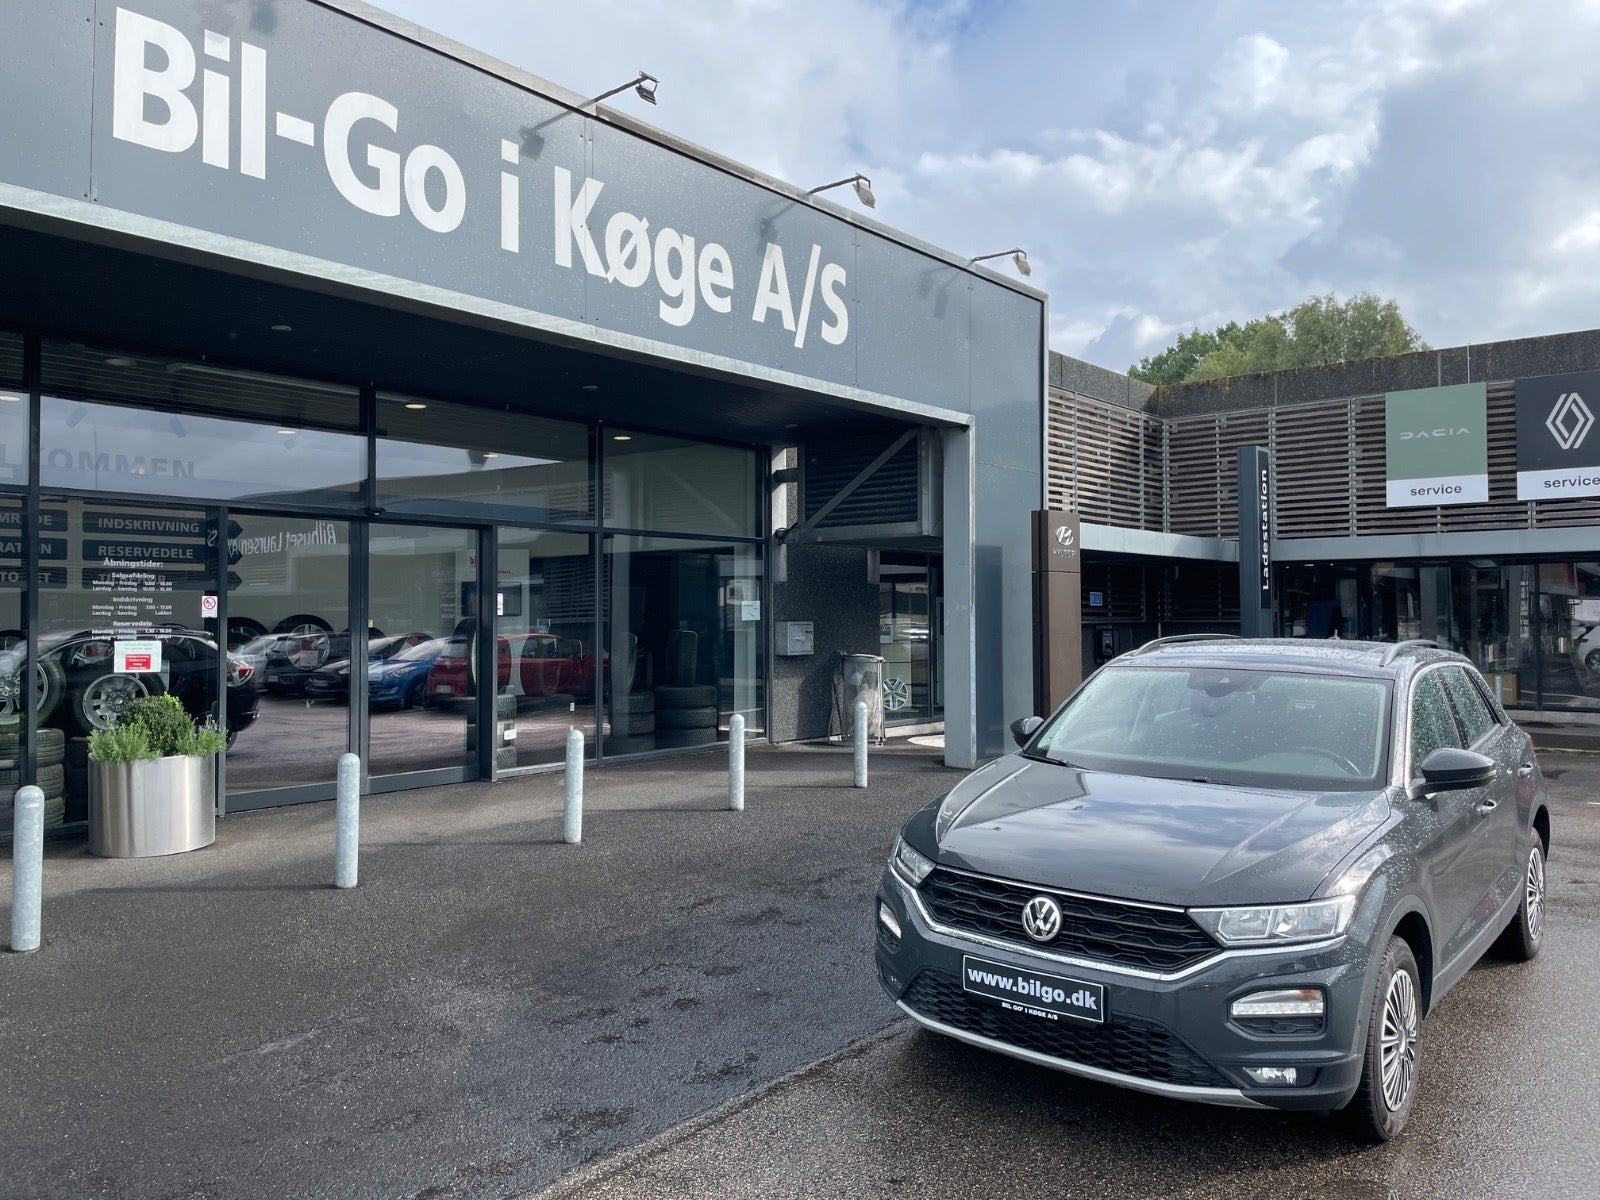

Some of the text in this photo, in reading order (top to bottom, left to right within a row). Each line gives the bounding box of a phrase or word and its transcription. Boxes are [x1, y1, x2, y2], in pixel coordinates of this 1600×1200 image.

[112, 6, 850, 349] Bil-Go i Køge A/S
[1400, 427, 1471, 440] DACIA
[1543, 476, 1600, 489] service
[1410, 484, 1462, 496] service
[98, 518, 200, 533] INDSKRIVNING
[1261, 469, 1269, 590] Ladestation
[98, 545, 194, 559] RESERVEDELE
[103, 557, 164, 569] Åbningstider:
[967, 967, 1098, 1010] www.bilgo.dk
